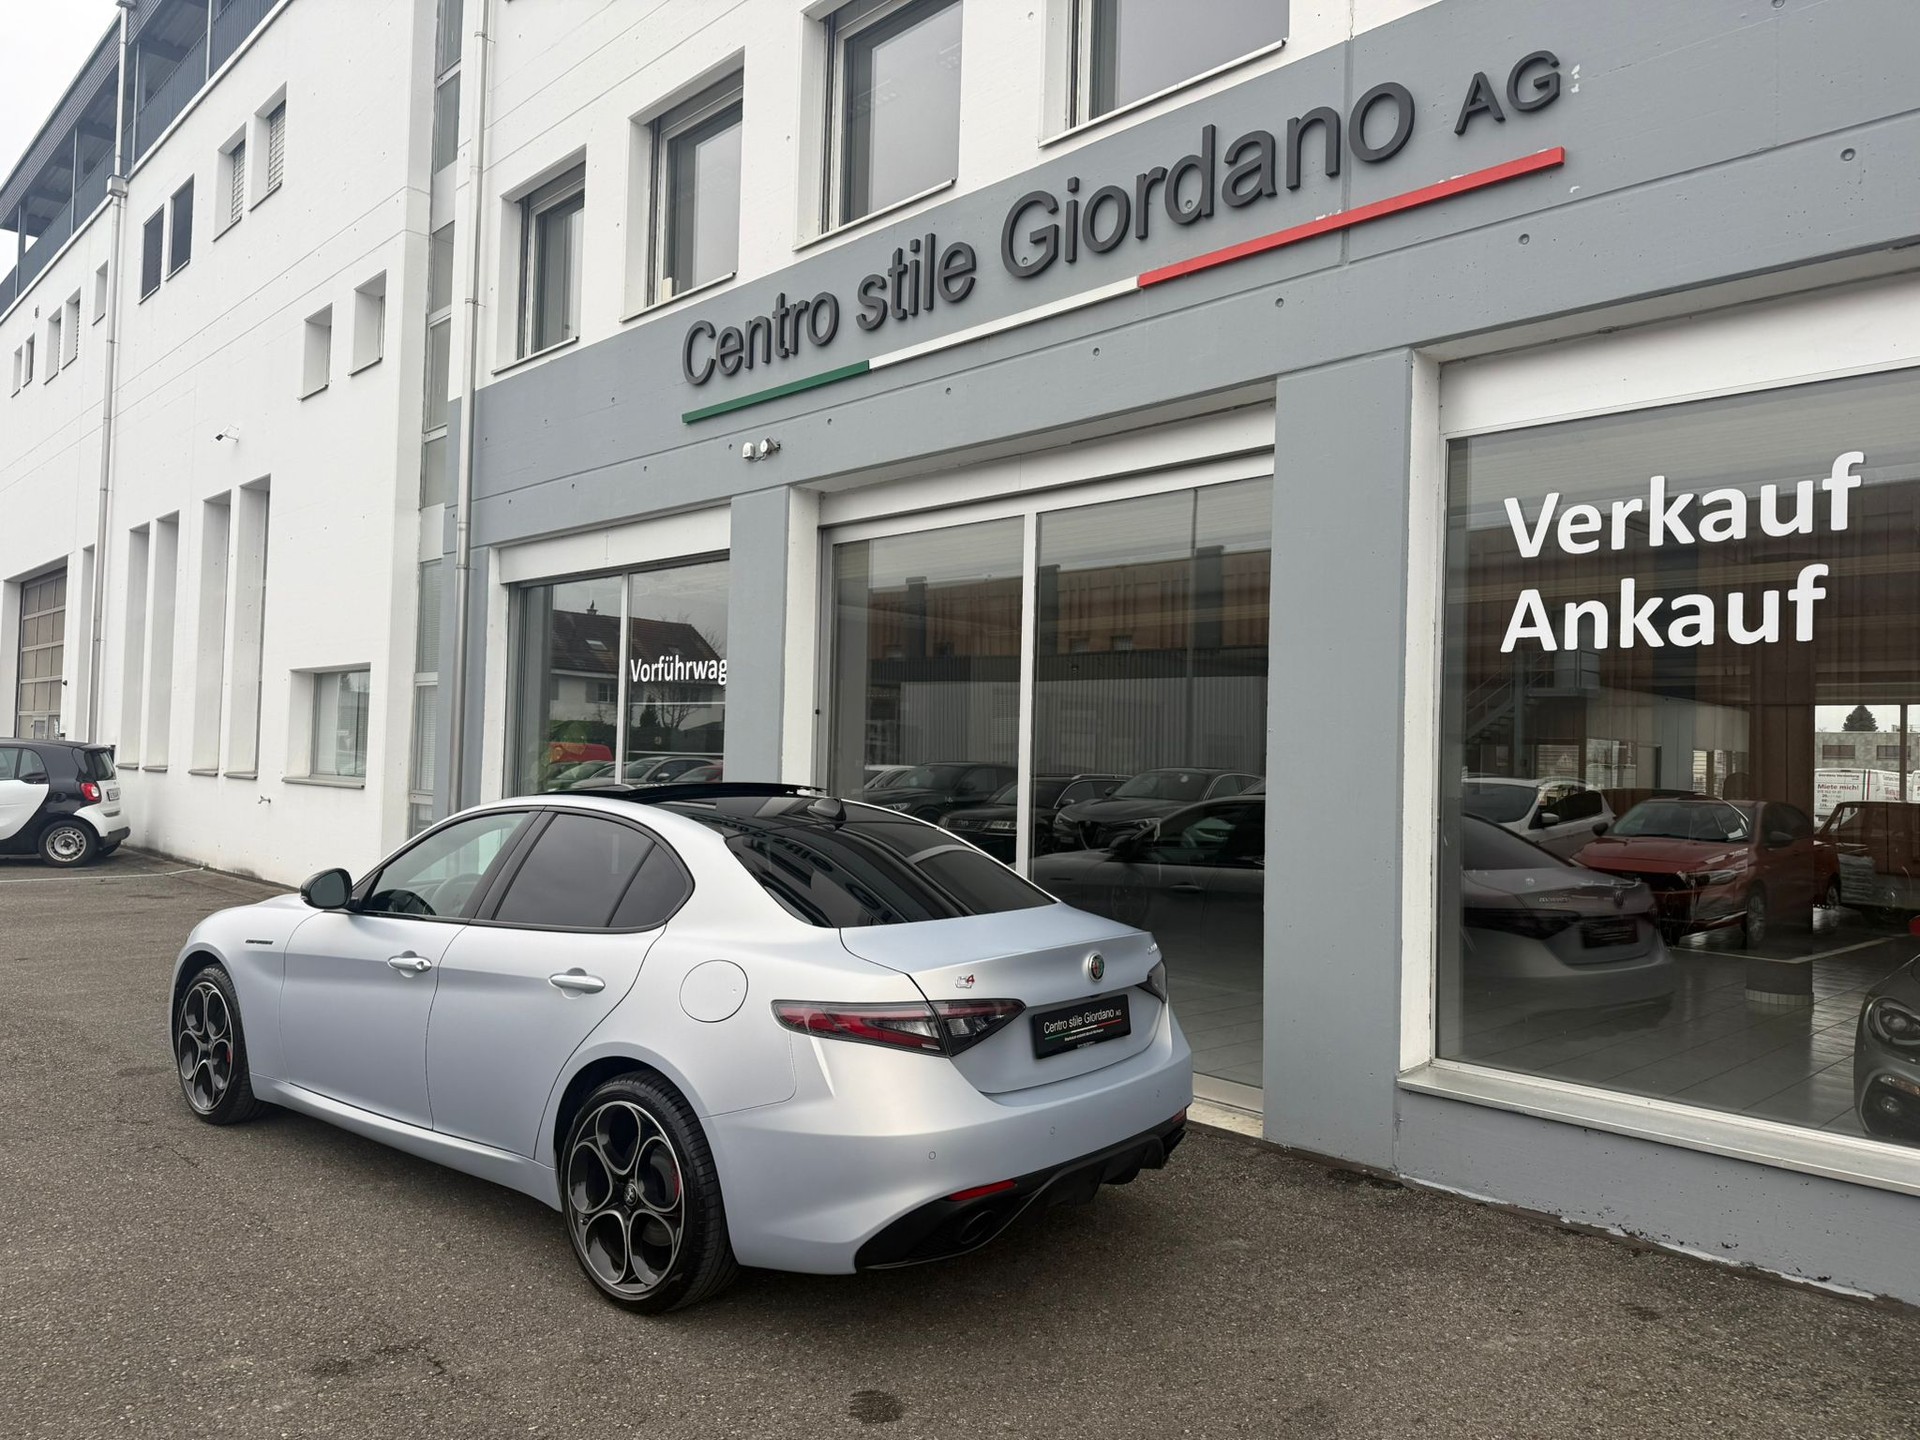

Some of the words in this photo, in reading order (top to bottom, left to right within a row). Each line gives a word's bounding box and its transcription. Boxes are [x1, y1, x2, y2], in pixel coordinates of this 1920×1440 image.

[682, 291, 840, 387] Centro
[856, 232, 977, 332] stile
[1002, 82, 1416, 280] Giordano
[1454, 50, 1562, 137] AG
[1503, 451, 1865, 559] Verkauf
[1500, 563, 1829, 654] Ankauf
[630, 654, 728, 686] Vorführwag
[1043, 1019, 1068, 1034] Centro
[1068, 1014, 1083, 1028] stile
[1084, 1008, 1114, 1024] Giordano
